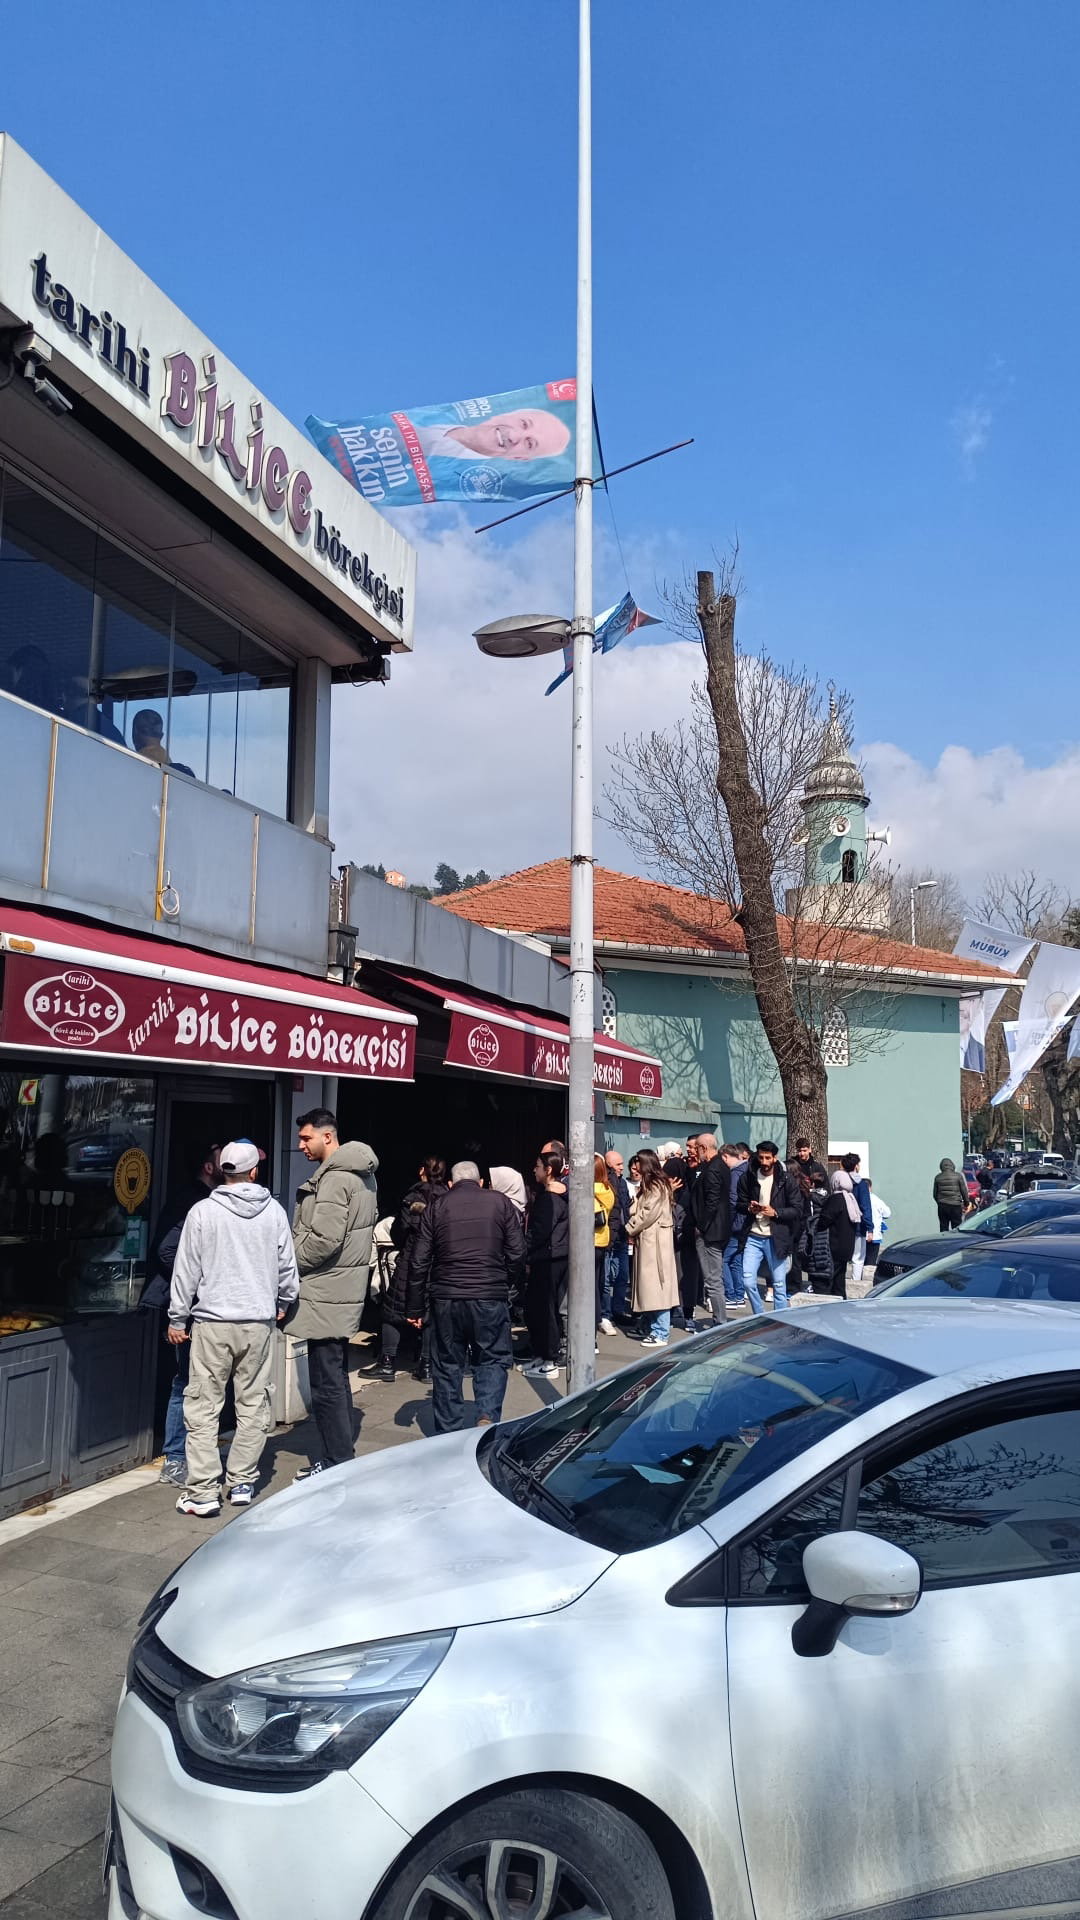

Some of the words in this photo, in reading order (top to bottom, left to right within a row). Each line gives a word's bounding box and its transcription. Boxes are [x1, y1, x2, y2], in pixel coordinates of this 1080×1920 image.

[31, 251, 150, 399] tarihi
[314, 508, 403, 624] börekçisi
[370, 427, 413, 488] senin
[404, 429, 418, 443] İYİ
[410, 446, 424, 465] BİR
[337, 425, 385, 502] hakkın
[416, 464, 433, 502] YAŞAM
[68, 975, 91, 986] tarihi
[127, 987, 176, 1052] tarihi
[175, 992, 277, 1055] BİLİCE
[288, 1013, 407, 1074] BÖREKÇİSİ
[545, 1043, 570, 1076] BİLİC
[593, 1058, 623, 1089] REKÇİSİ
